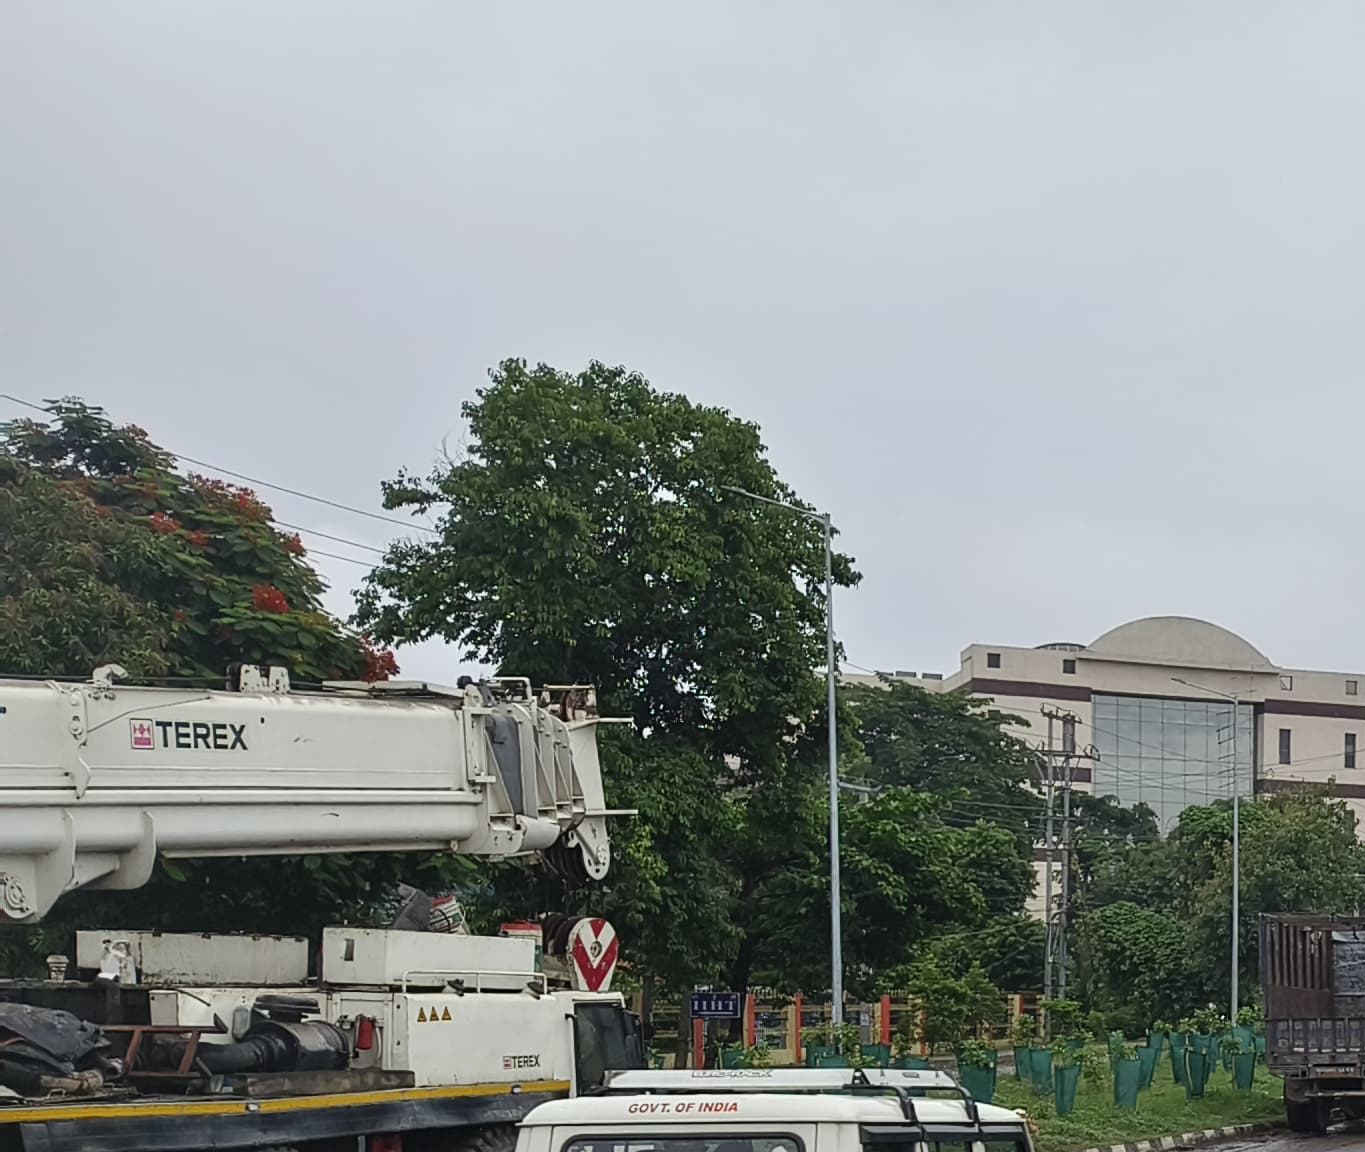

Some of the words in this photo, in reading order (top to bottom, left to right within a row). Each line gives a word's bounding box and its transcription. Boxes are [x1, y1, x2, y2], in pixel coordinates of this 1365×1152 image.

[156, 721, 248, 750] TEREX
[511, 1054, 541, 1069] TEREX
[628, 1103, 671, 1114] GOVT.
[675, 1103, 695, 1113] OF
[698, 1102, 739, 1112] INDIA
